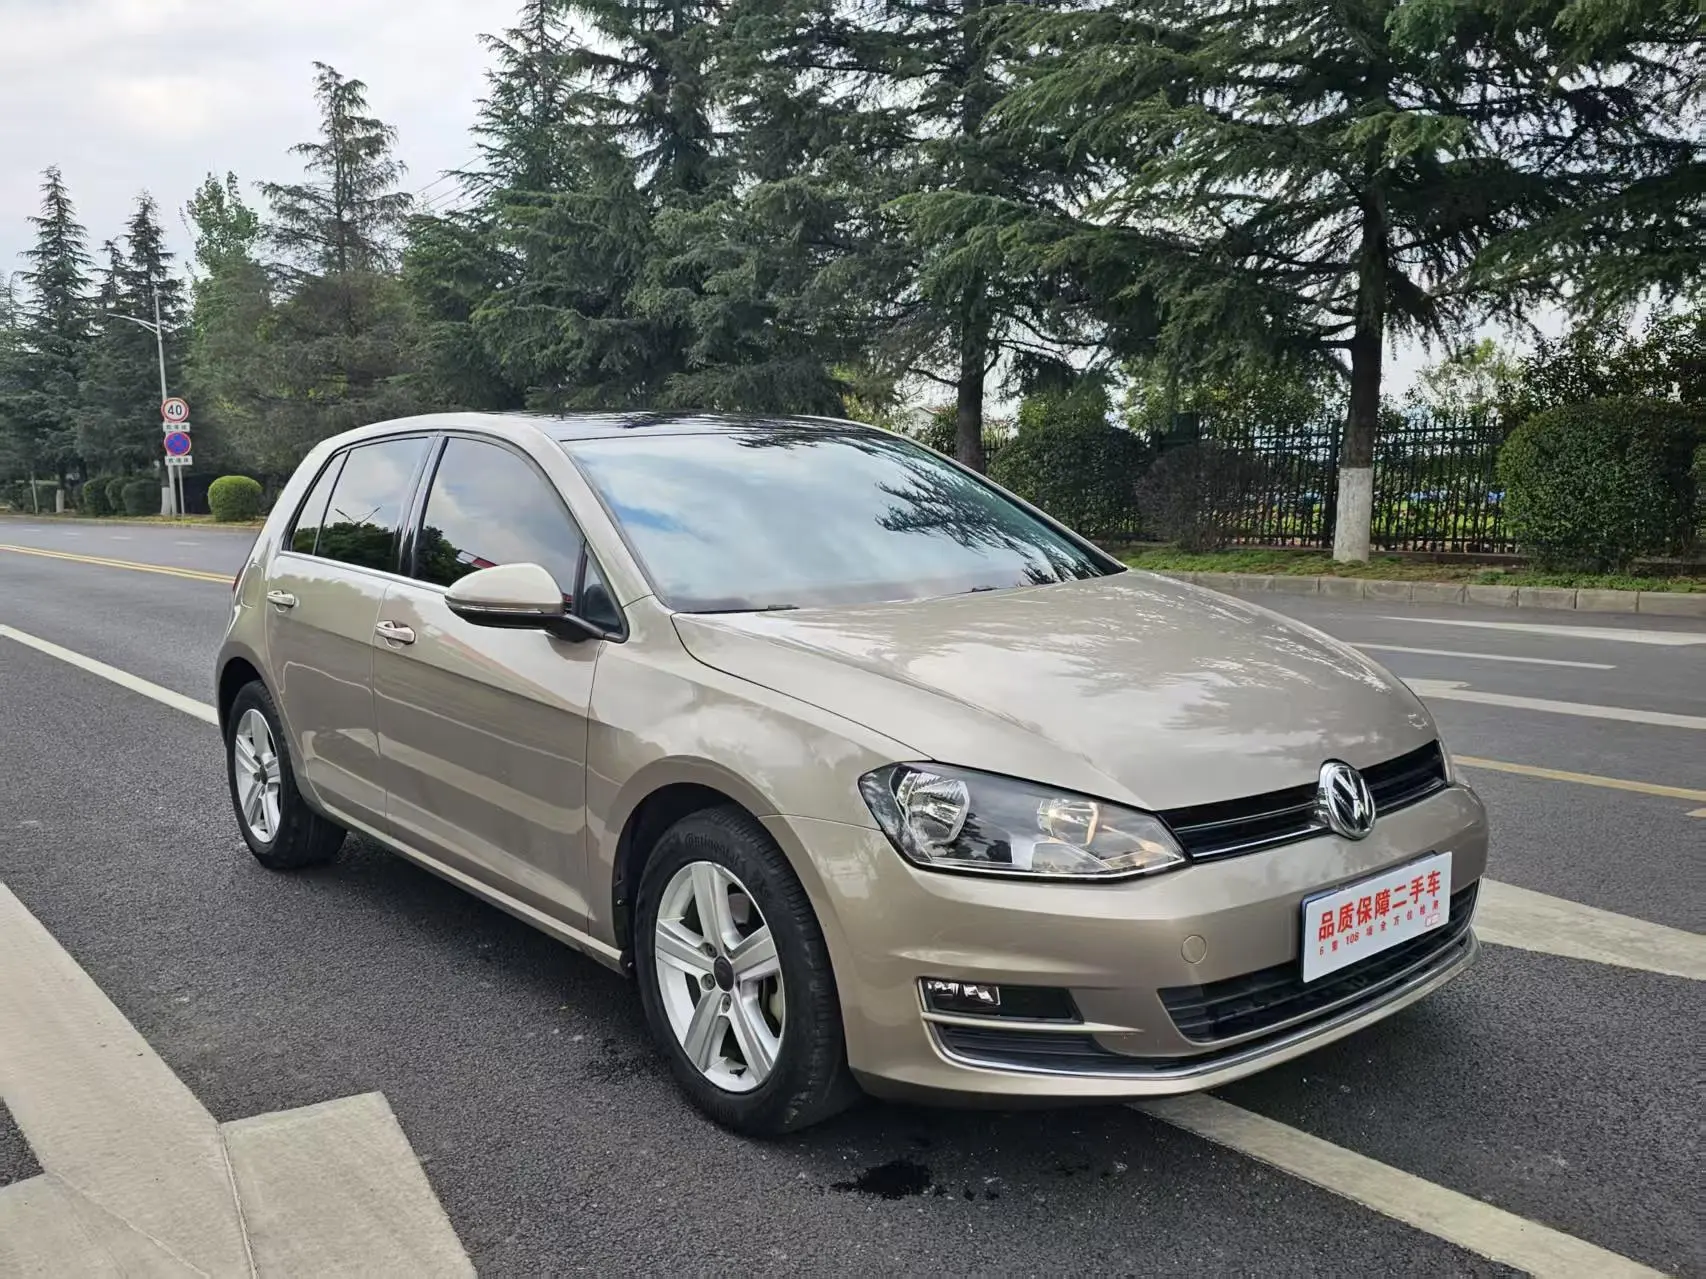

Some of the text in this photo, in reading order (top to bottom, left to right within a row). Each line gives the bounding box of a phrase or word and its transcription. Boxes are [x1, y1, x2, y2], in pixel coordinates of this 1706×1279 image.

[168, 405, 182, 416] 40
[1318, 870, 1441, 942] 品质保障二手车
